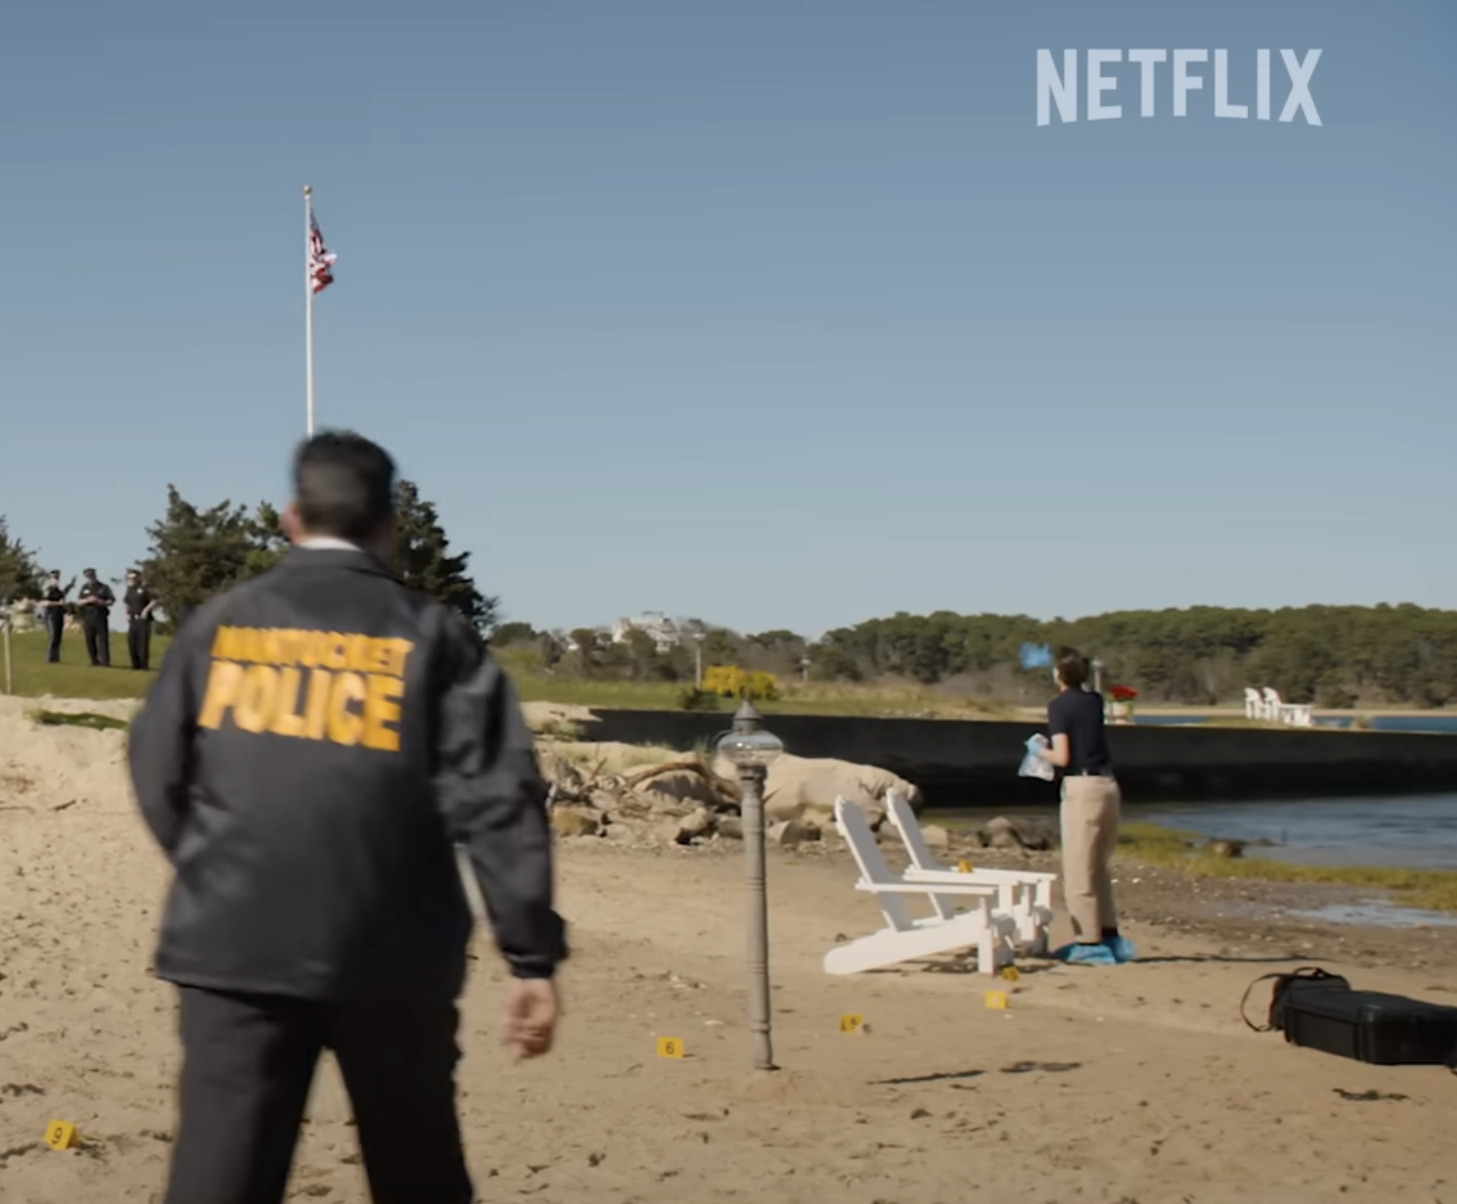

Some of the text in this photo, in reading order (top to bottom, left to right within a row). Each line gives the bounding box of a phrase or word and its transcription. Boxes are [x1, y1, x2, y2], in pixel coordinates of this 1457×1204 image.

[197, 660, 405, 751] POLICE
[665, 1041, 675, 1055] 6
[52, 1127, 63, 1145] 9
